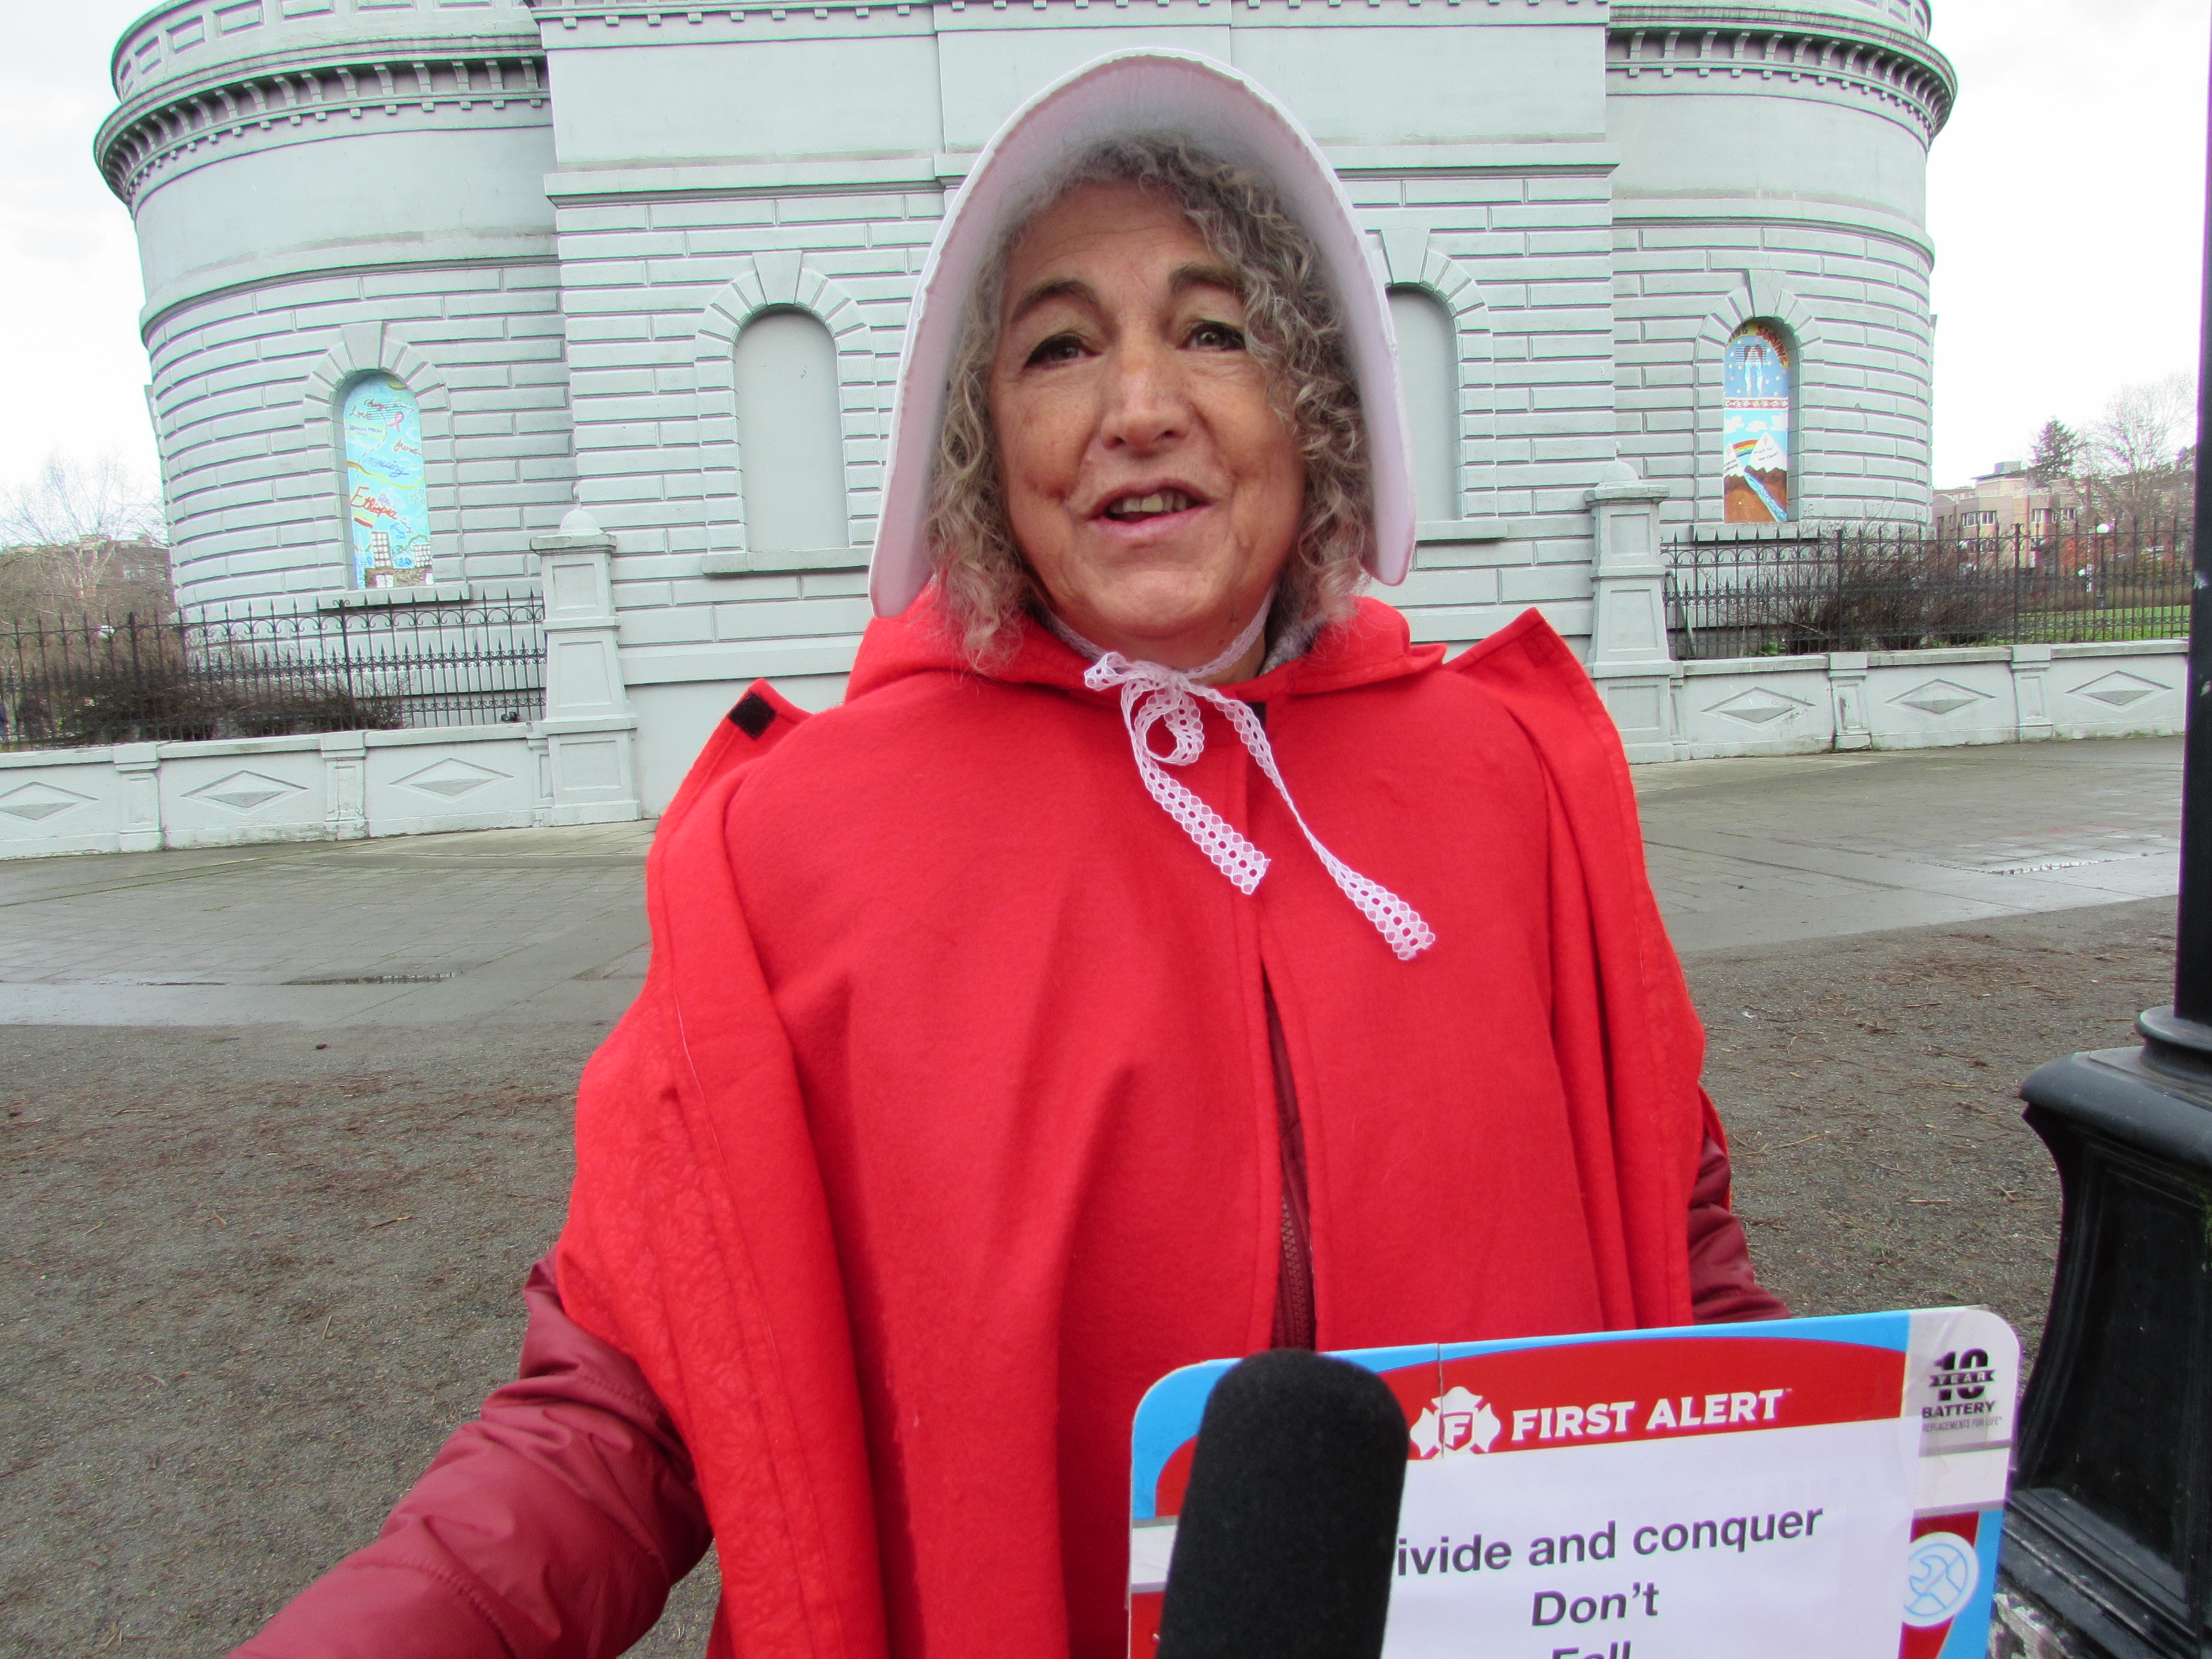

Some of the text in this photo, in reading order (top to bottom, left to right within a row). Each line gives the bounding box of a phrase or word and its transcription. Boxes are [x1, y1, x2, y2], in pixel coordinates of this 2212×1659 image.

[351, 486, 397, 520] Ethiopia
[1937, 1372, 1986, 1385] YEAR
[1443, 1388, 1784, 1447] F FIRST ALERT
[1922, 1401, 1996, 1418] BATTERY
[1397, 1507, 1824, 1576] ivide and conquer
[1531, 1582, 1660, 1627] Don't
[1549, 1640, 1631, 1659] ll
